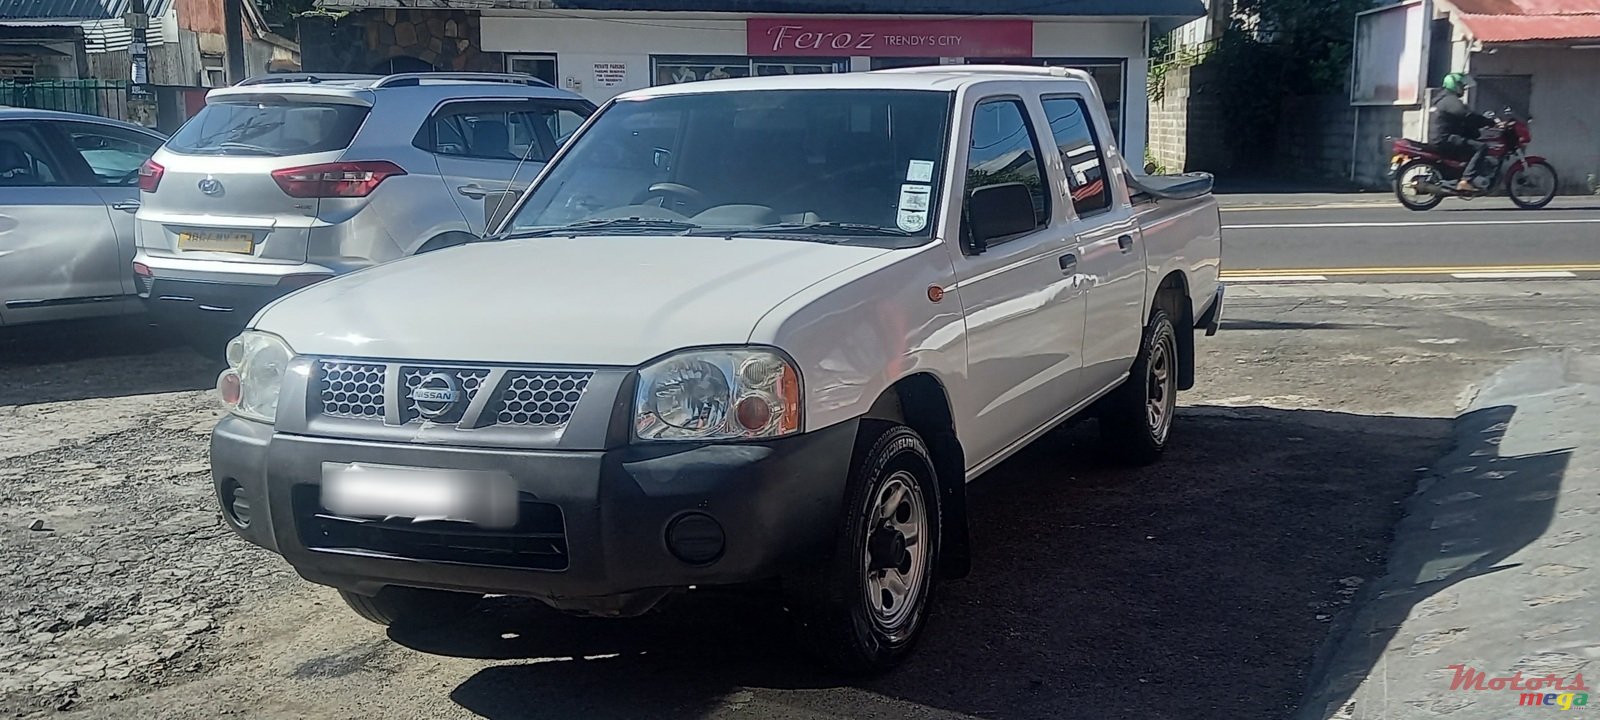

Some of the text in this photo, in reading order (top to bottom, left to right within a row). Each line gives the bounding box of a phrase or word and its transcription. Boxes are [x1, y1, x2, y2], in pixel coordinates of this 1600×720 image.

[767, 25, 962, 51] Feroz TRENDY'S CITY
[415, 391, 451, 400] NISSAN
